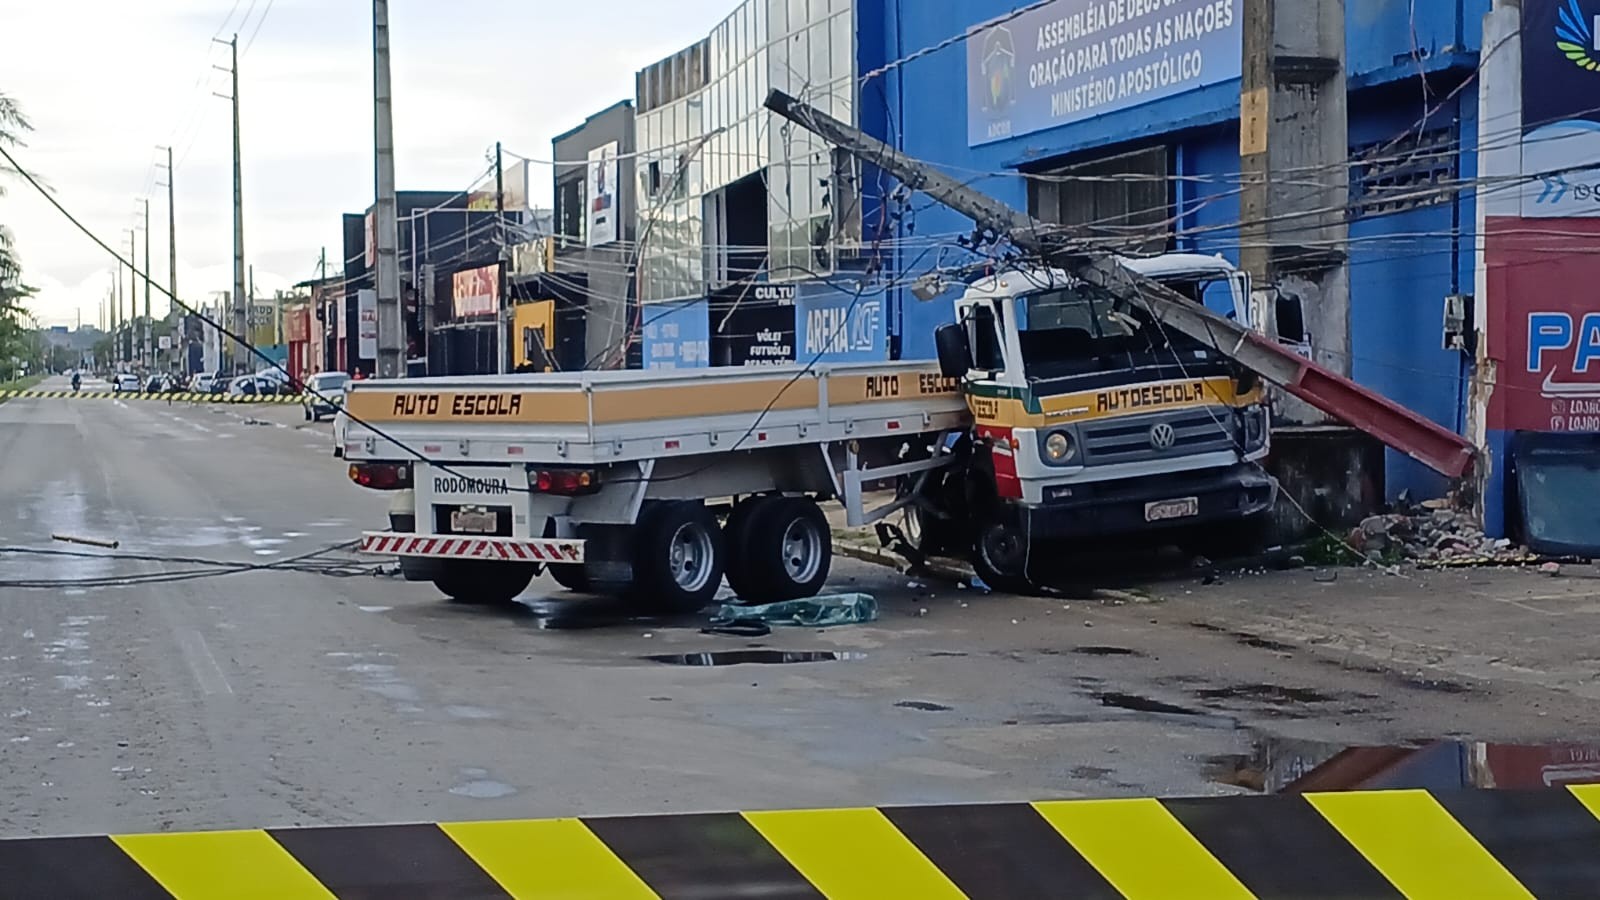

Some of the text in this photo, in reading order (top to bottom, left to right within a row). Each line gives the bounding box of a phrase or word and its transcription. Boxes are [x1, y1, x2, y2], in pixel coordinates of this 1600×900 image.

[1037, 1, 1106, 51] ASSEMBLÉIA
[1109, 0, 1125, 26] DE
[1029, 49, 1076, 88] ORAÇÃO
[1077, 41, 1108, 74] PARA
[1110, 26, 1152, 63] TODAS
[1154, 19, 1172, 50] AS
[1051, 50, 1202, 117] MINISTÉRIO APOSTÓLICO
[805, 307, 849, 354] ARENA
[393, 394, 522, 415] AUTO ESCOLA
[866, 375, 899, 397] AUTO
[1097, 383, 1203, 412] AUTOESCOLA
[434, 477, 508, 495] RODOMOURA
